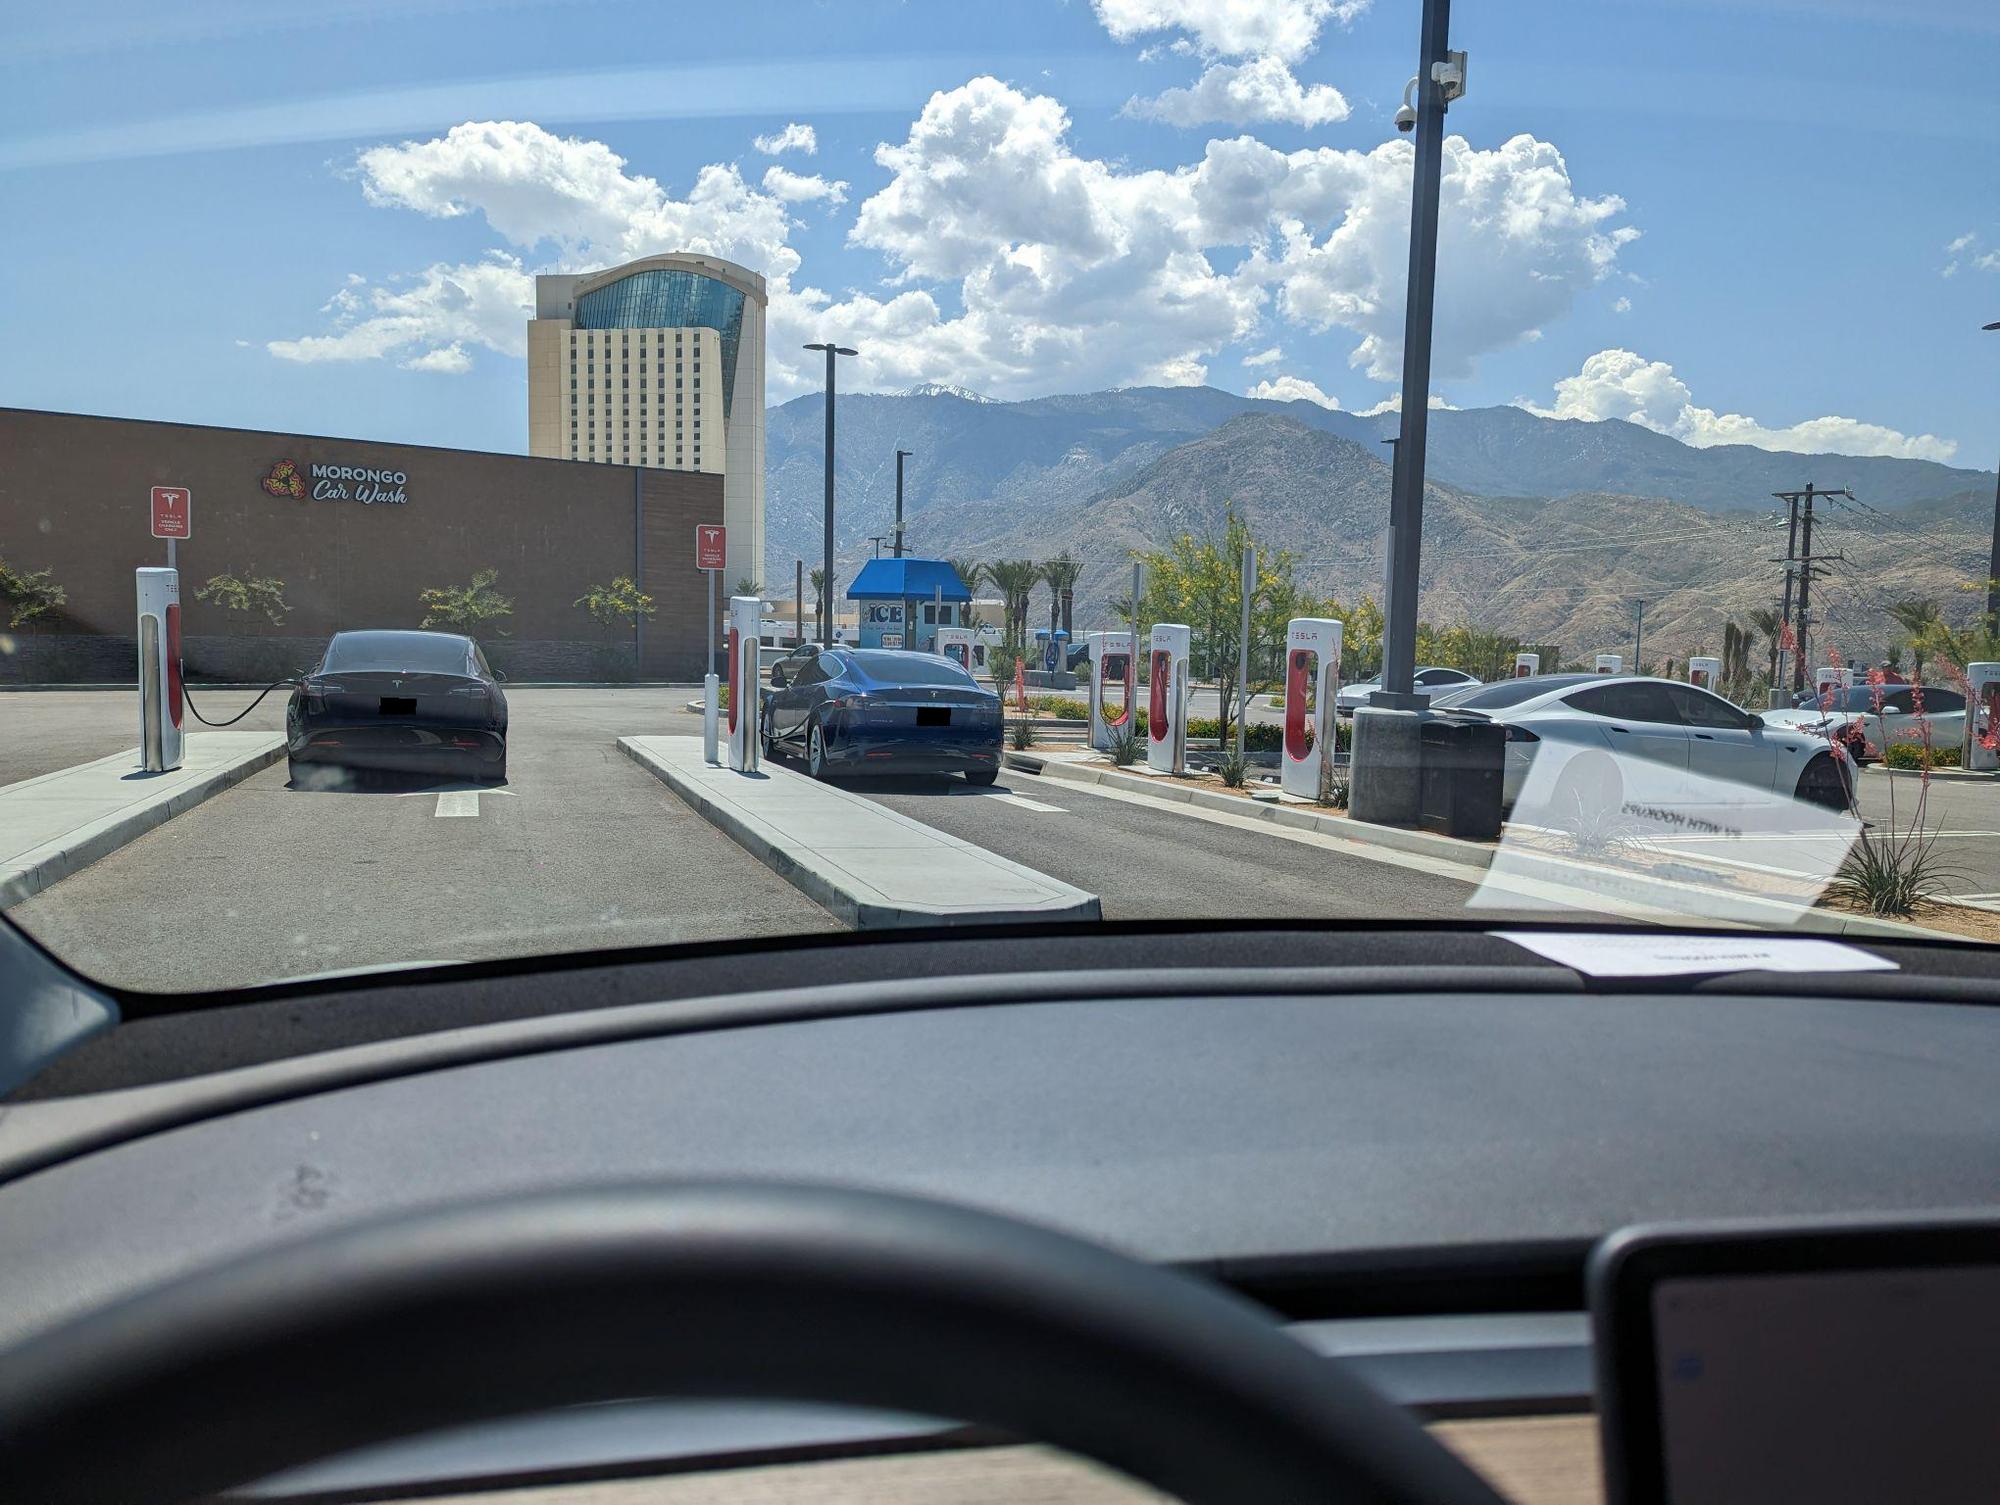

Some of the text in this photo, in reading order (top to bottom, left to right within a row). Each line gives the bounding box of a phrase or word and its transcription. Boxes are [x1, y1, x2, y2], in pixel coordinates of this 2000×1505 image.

[312, 464, 407, 485] MORONGO
[313, 480, 408, 505] Car Wash
[868, 603, 903, 623] ICE
[1291, 632, 1318, 640] TESLA
